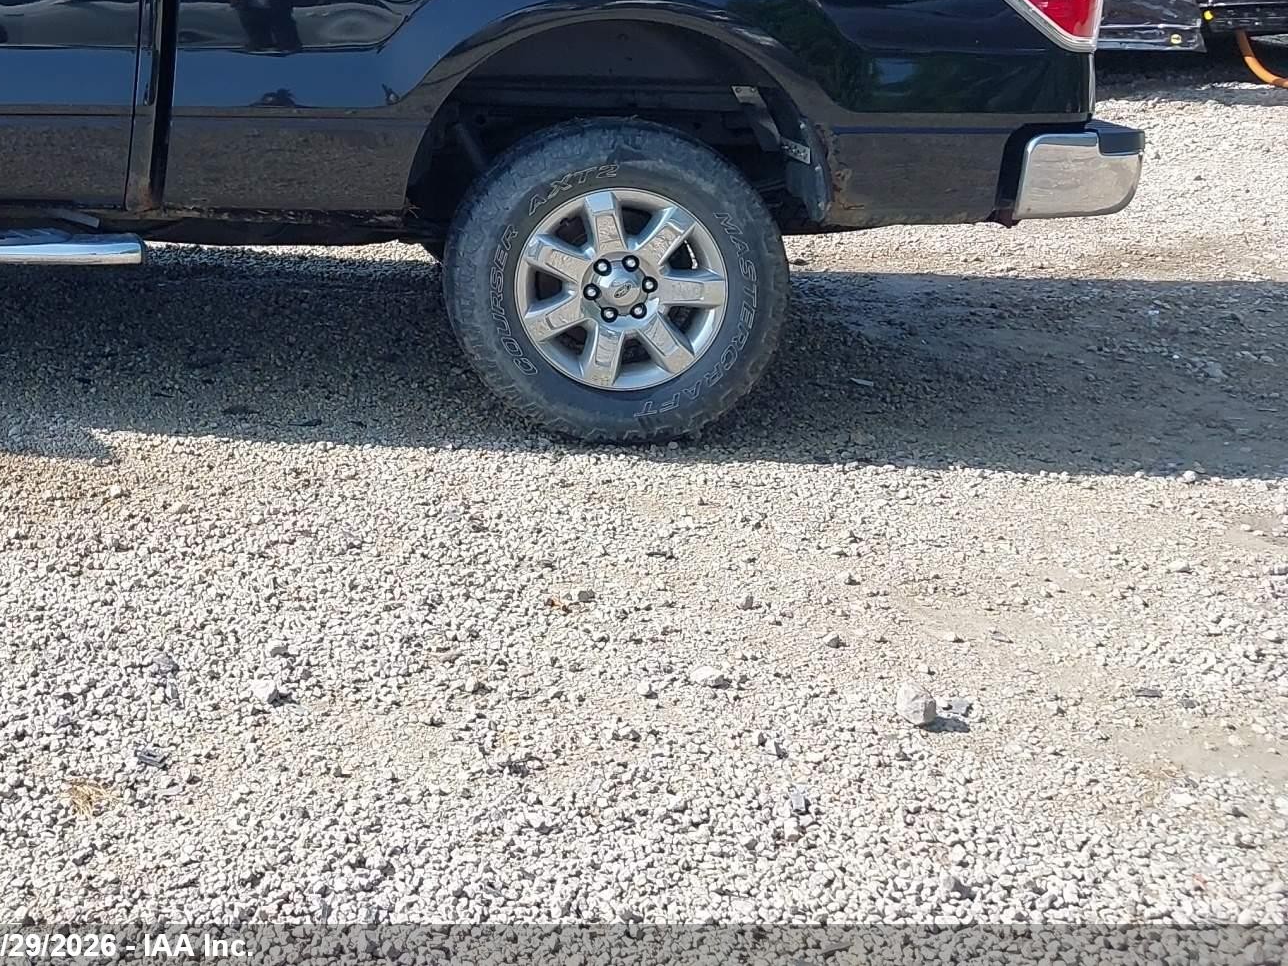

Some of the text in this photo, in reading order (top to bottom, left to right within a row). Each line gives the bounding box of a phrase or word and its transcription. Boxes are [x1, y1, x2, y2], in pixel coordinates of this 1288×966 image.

[489, 163, 620, 377] COURSER AXT2
[633, 212, 759, 417] MASTERCRAFT
